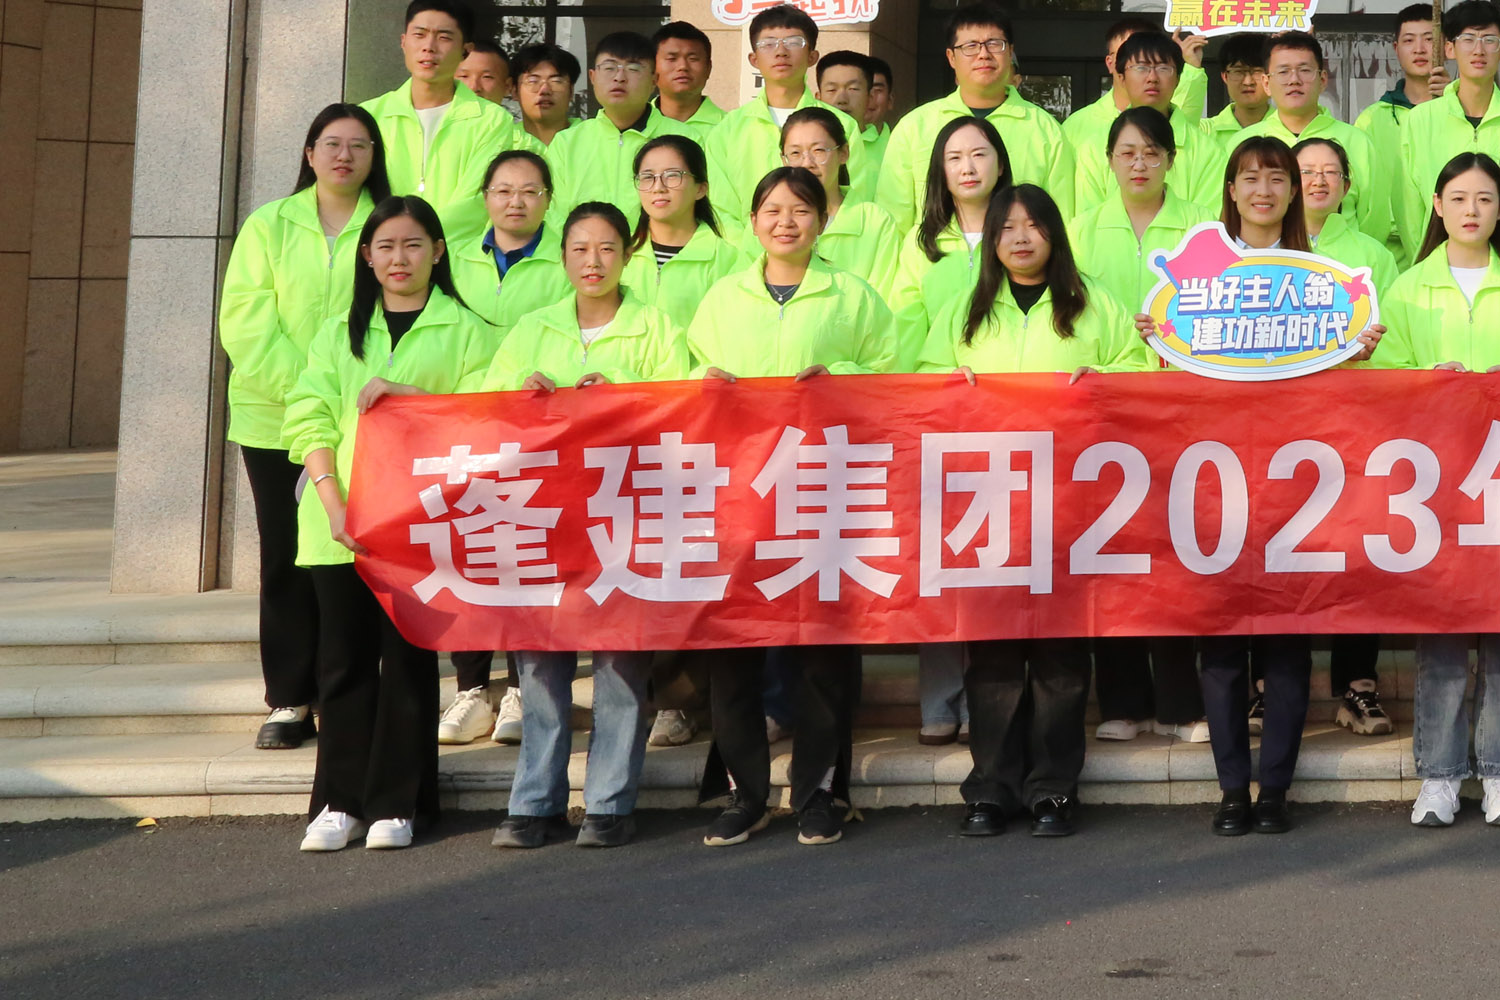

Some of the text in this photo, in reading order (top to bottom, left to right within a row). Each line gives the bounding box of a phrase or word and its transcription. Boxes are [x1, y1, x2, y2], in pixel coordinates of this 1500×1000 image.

[1177, 272, 1335, 314] 当好主人翁
[1190, 312, 1349, 355] 建功新时代
